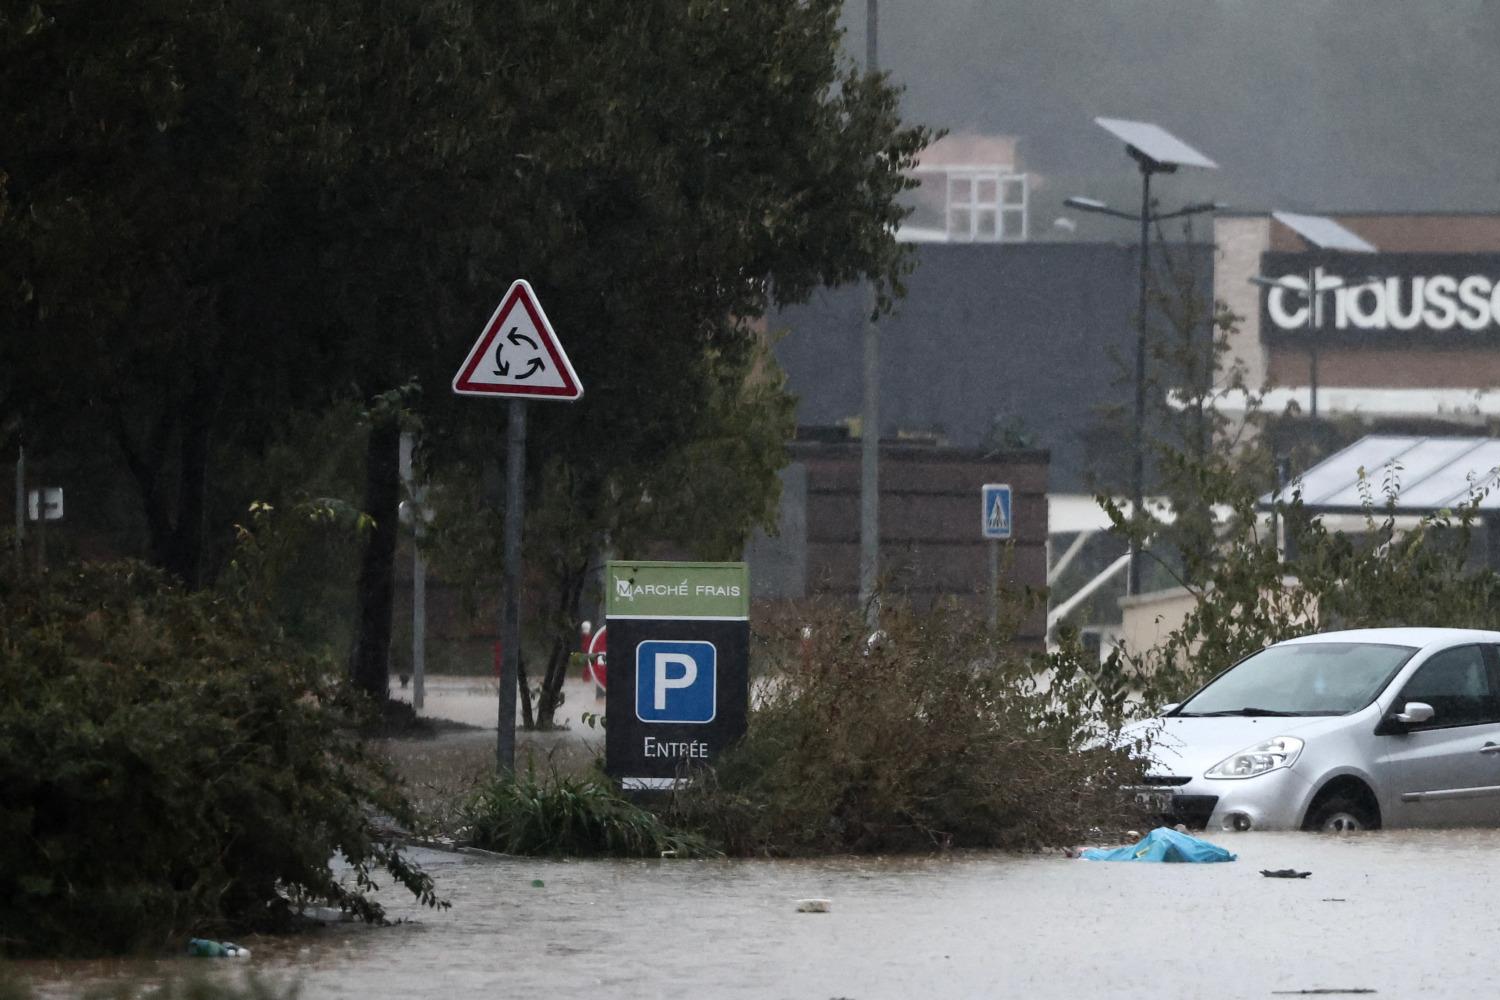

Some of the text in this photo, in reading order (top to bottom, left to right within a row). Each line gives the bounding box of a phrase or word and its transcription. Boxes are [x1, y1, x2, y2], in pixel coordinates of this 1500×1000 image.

[616, 579, 741, 597] MARCHÉ FRAIS
[654, 652, 698, 710] P
